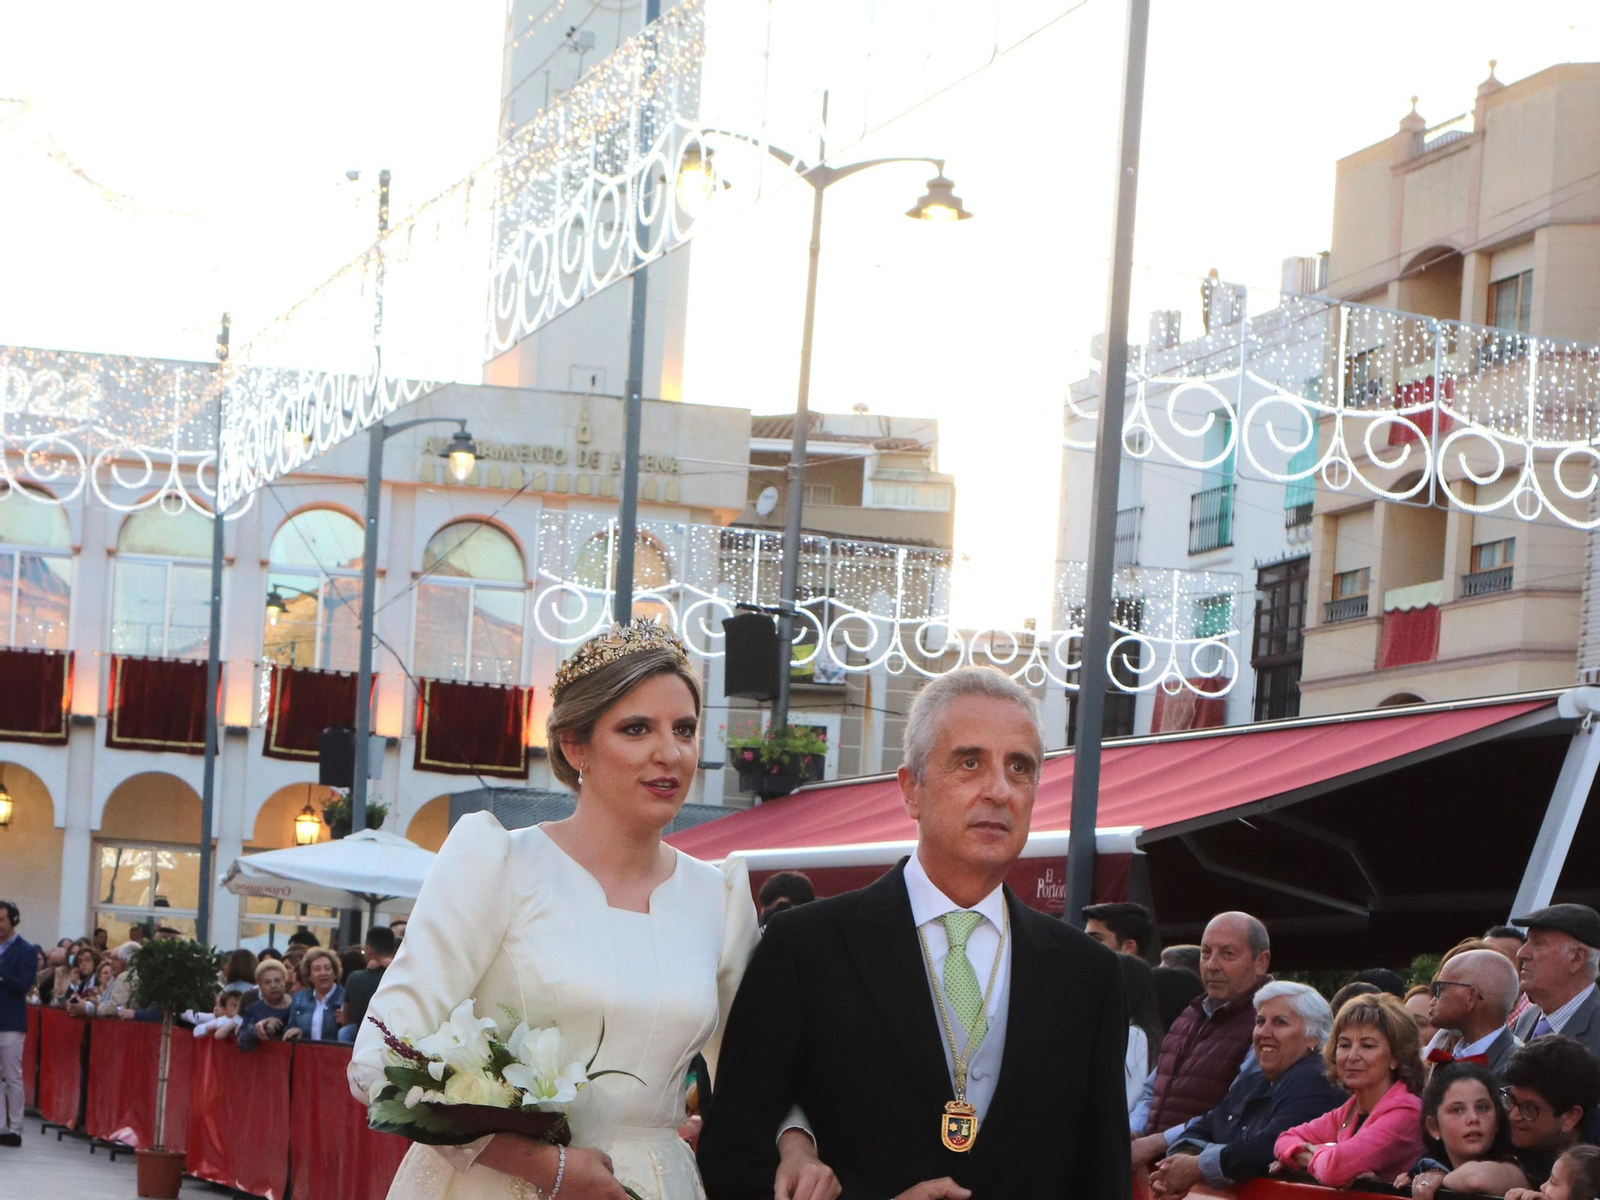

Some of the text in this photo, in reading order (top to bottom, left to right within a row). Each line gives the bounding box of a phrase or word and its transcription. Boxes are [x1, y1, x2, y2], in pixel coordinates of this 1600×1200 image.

[422, 436, 680, 474] AYTAMIENTO DE LENA
[1045, 868, 1054, 883] El
[1036, 878, 1067, 899] Portón
